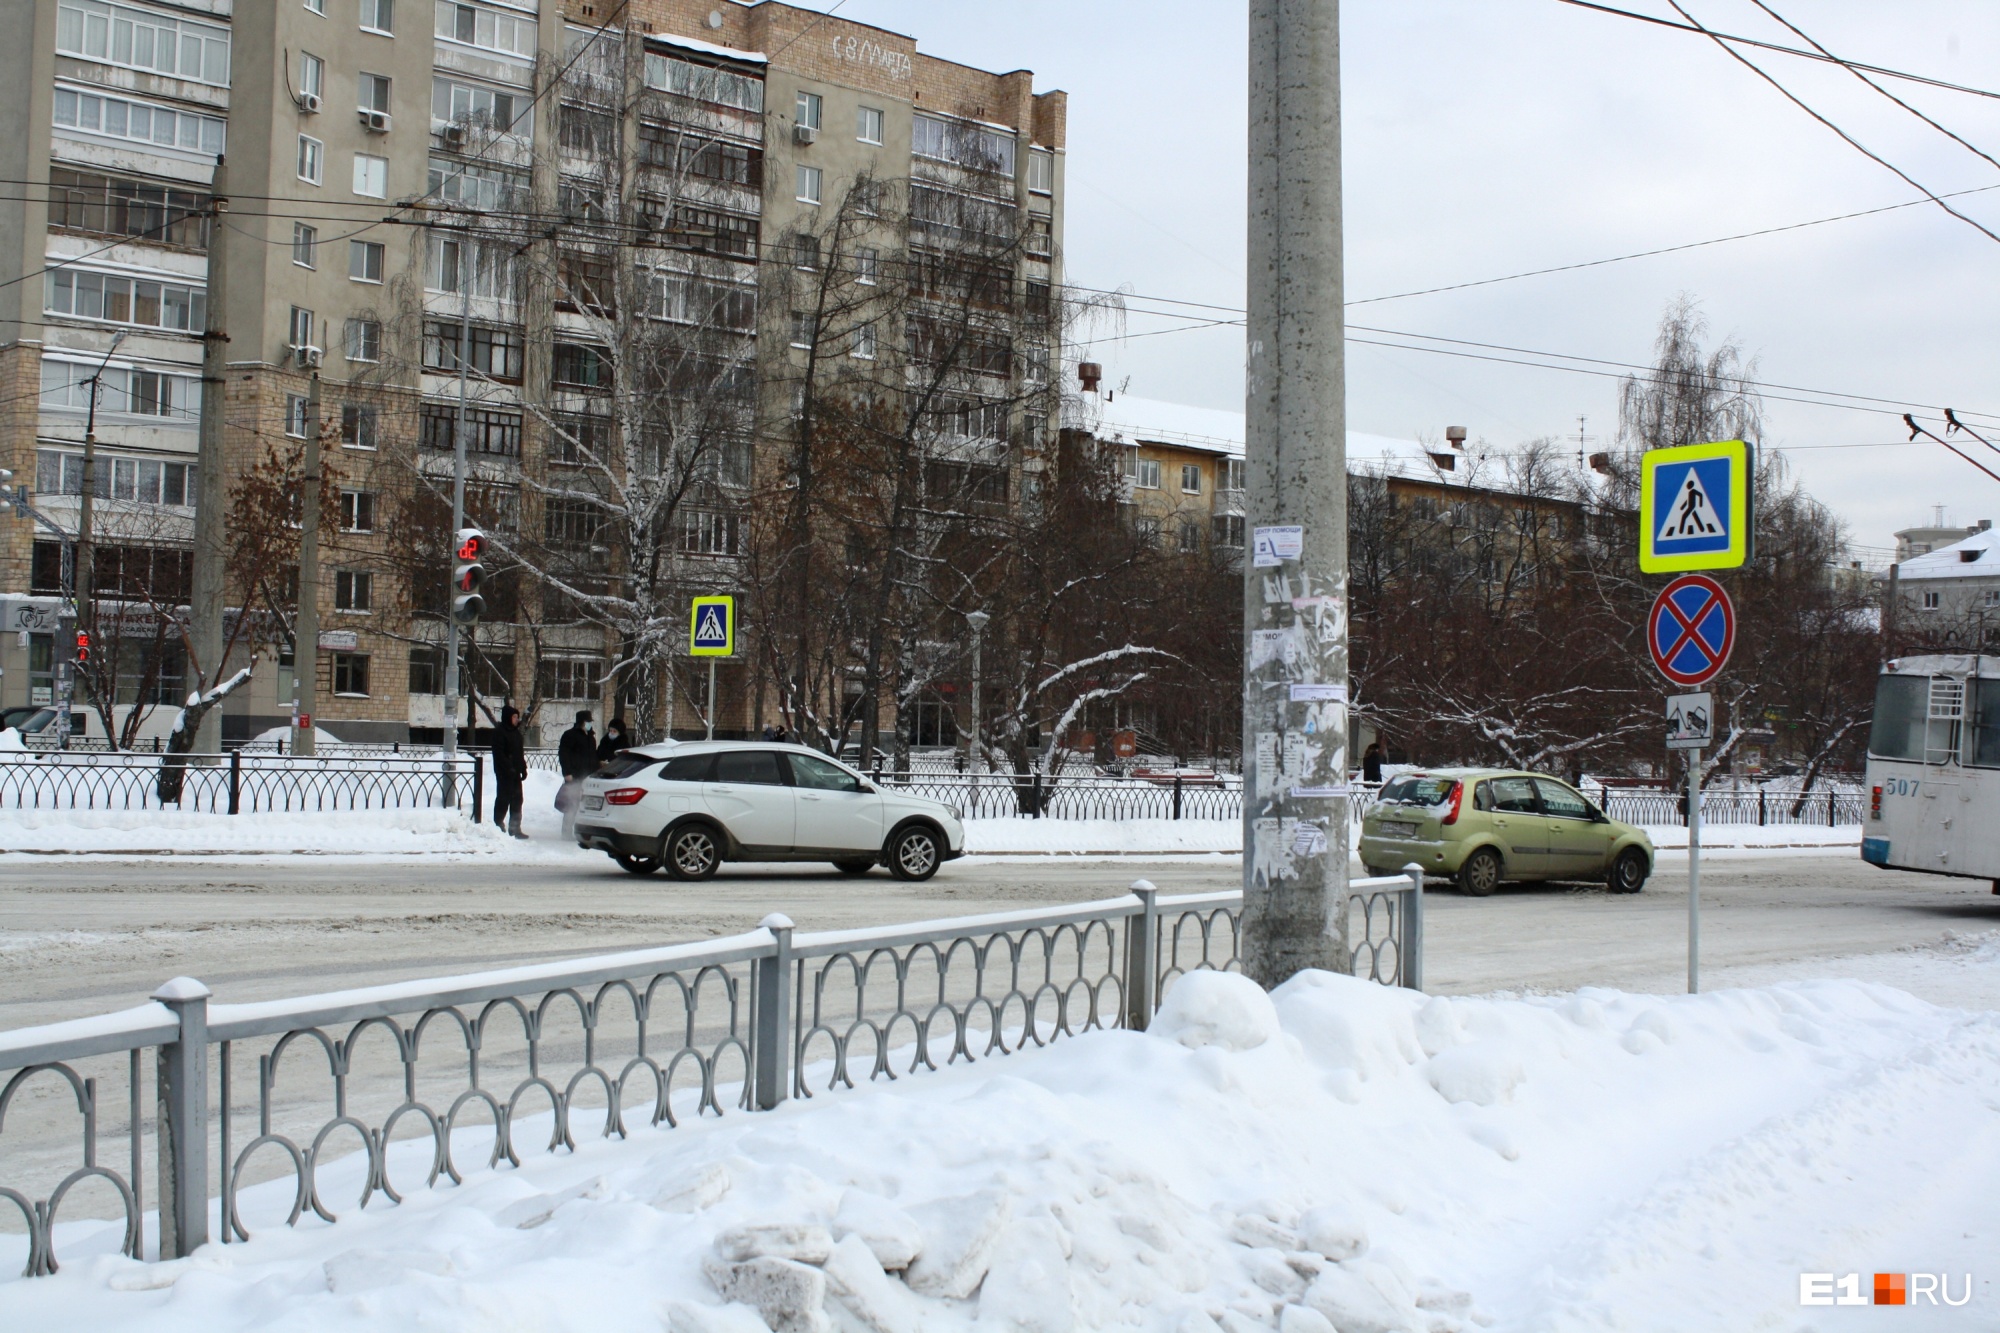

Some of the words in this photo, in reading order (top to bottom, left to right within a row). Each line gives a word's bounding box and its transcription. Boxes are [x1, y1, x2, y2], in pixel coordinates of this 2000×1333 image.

[846, 36, 858, 60] 8
[1255, 527, 1271, 535] ЦЕНТР
[1272, 526, 1301, 534] ПОМОЩИ
[1886, 777, 1920, 797] 507
